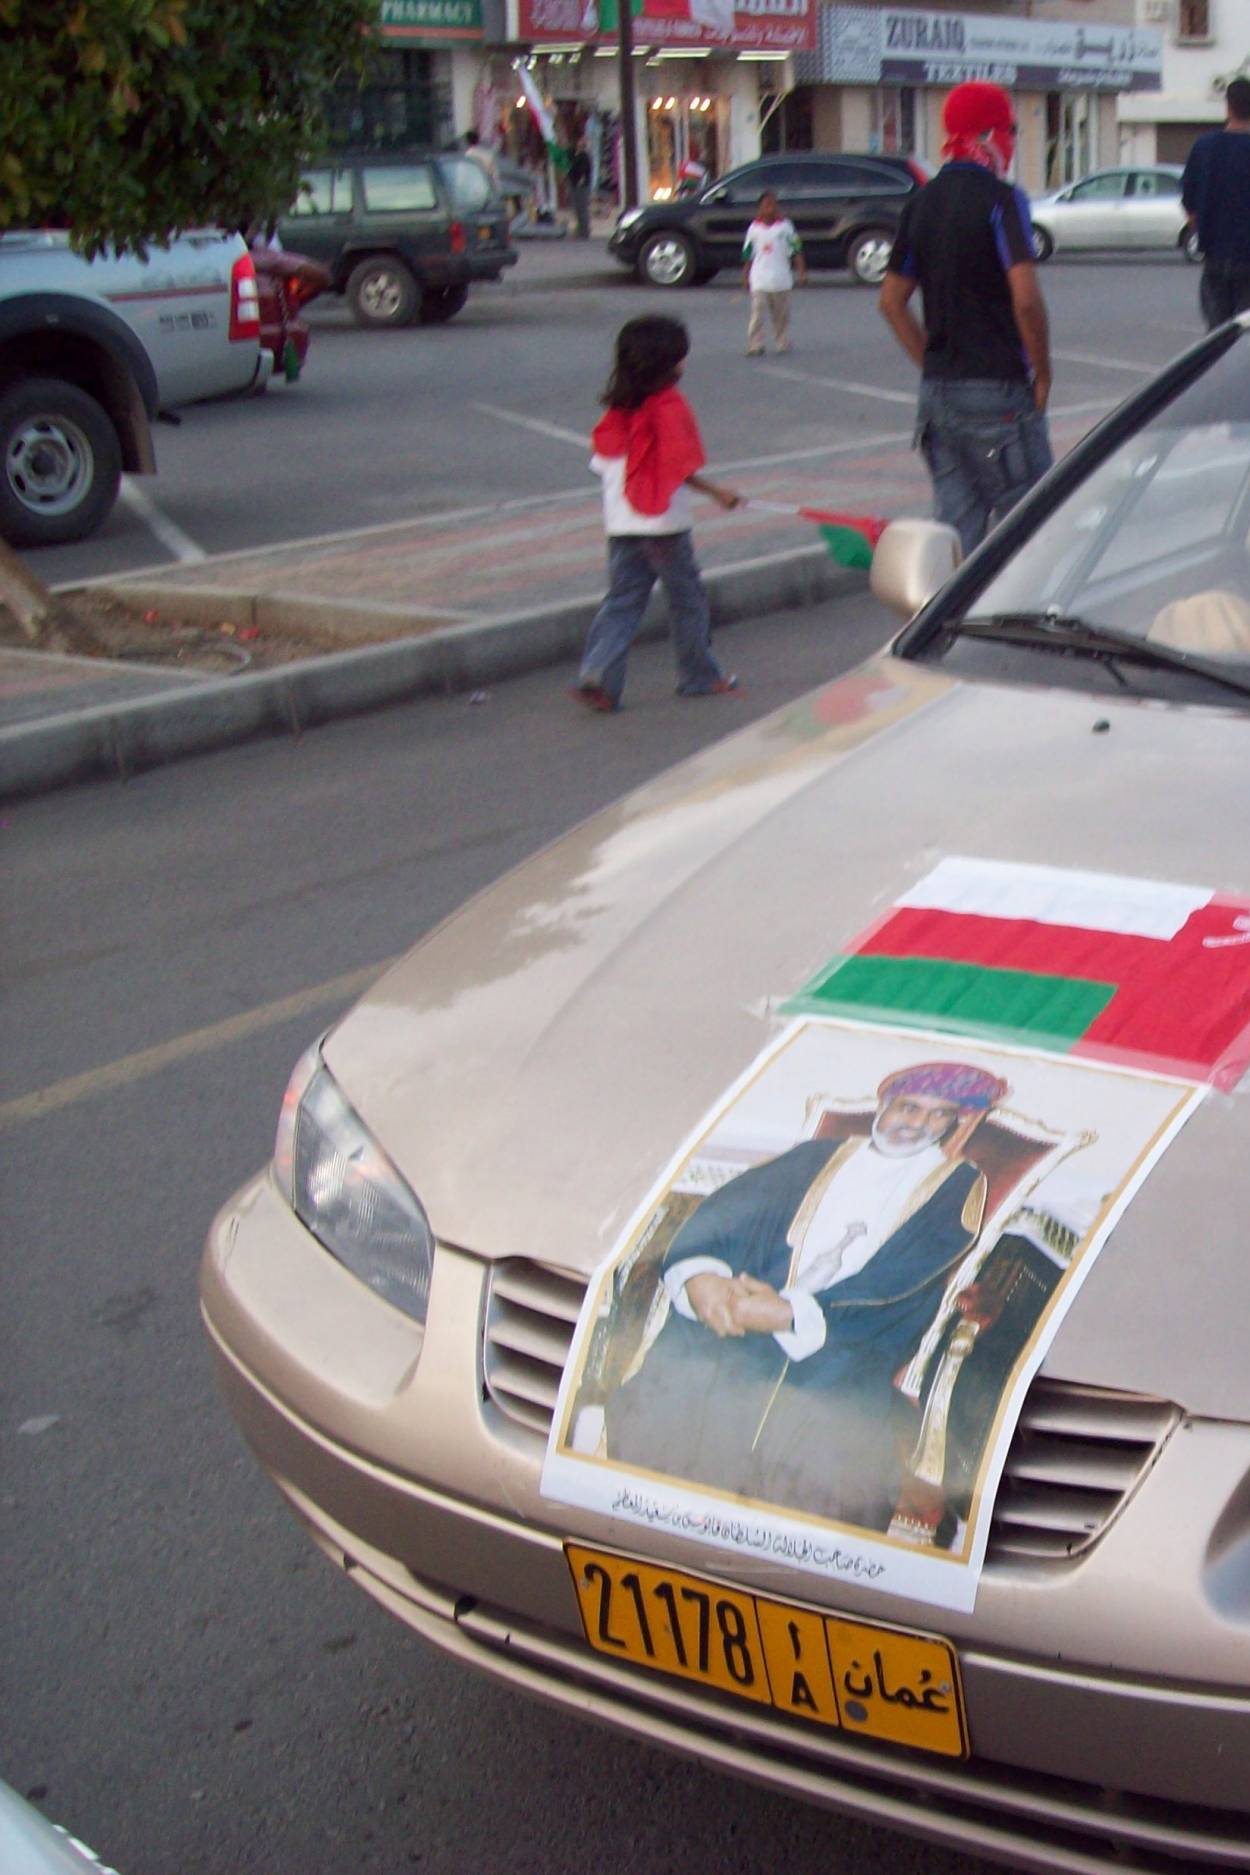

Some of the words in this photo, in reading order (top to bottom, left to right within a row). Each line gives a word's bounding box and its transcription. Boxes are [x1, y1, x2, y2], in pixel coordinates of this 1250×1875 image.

[381, 0, 473, 25] PHARMACY
[886, 15, 965, 54] ZURAIQ
[923, 62, 1017, 84] TEXTILES
[584, 1563, 755, 1687] 21178
[791, 1671, 820, 1713] A
